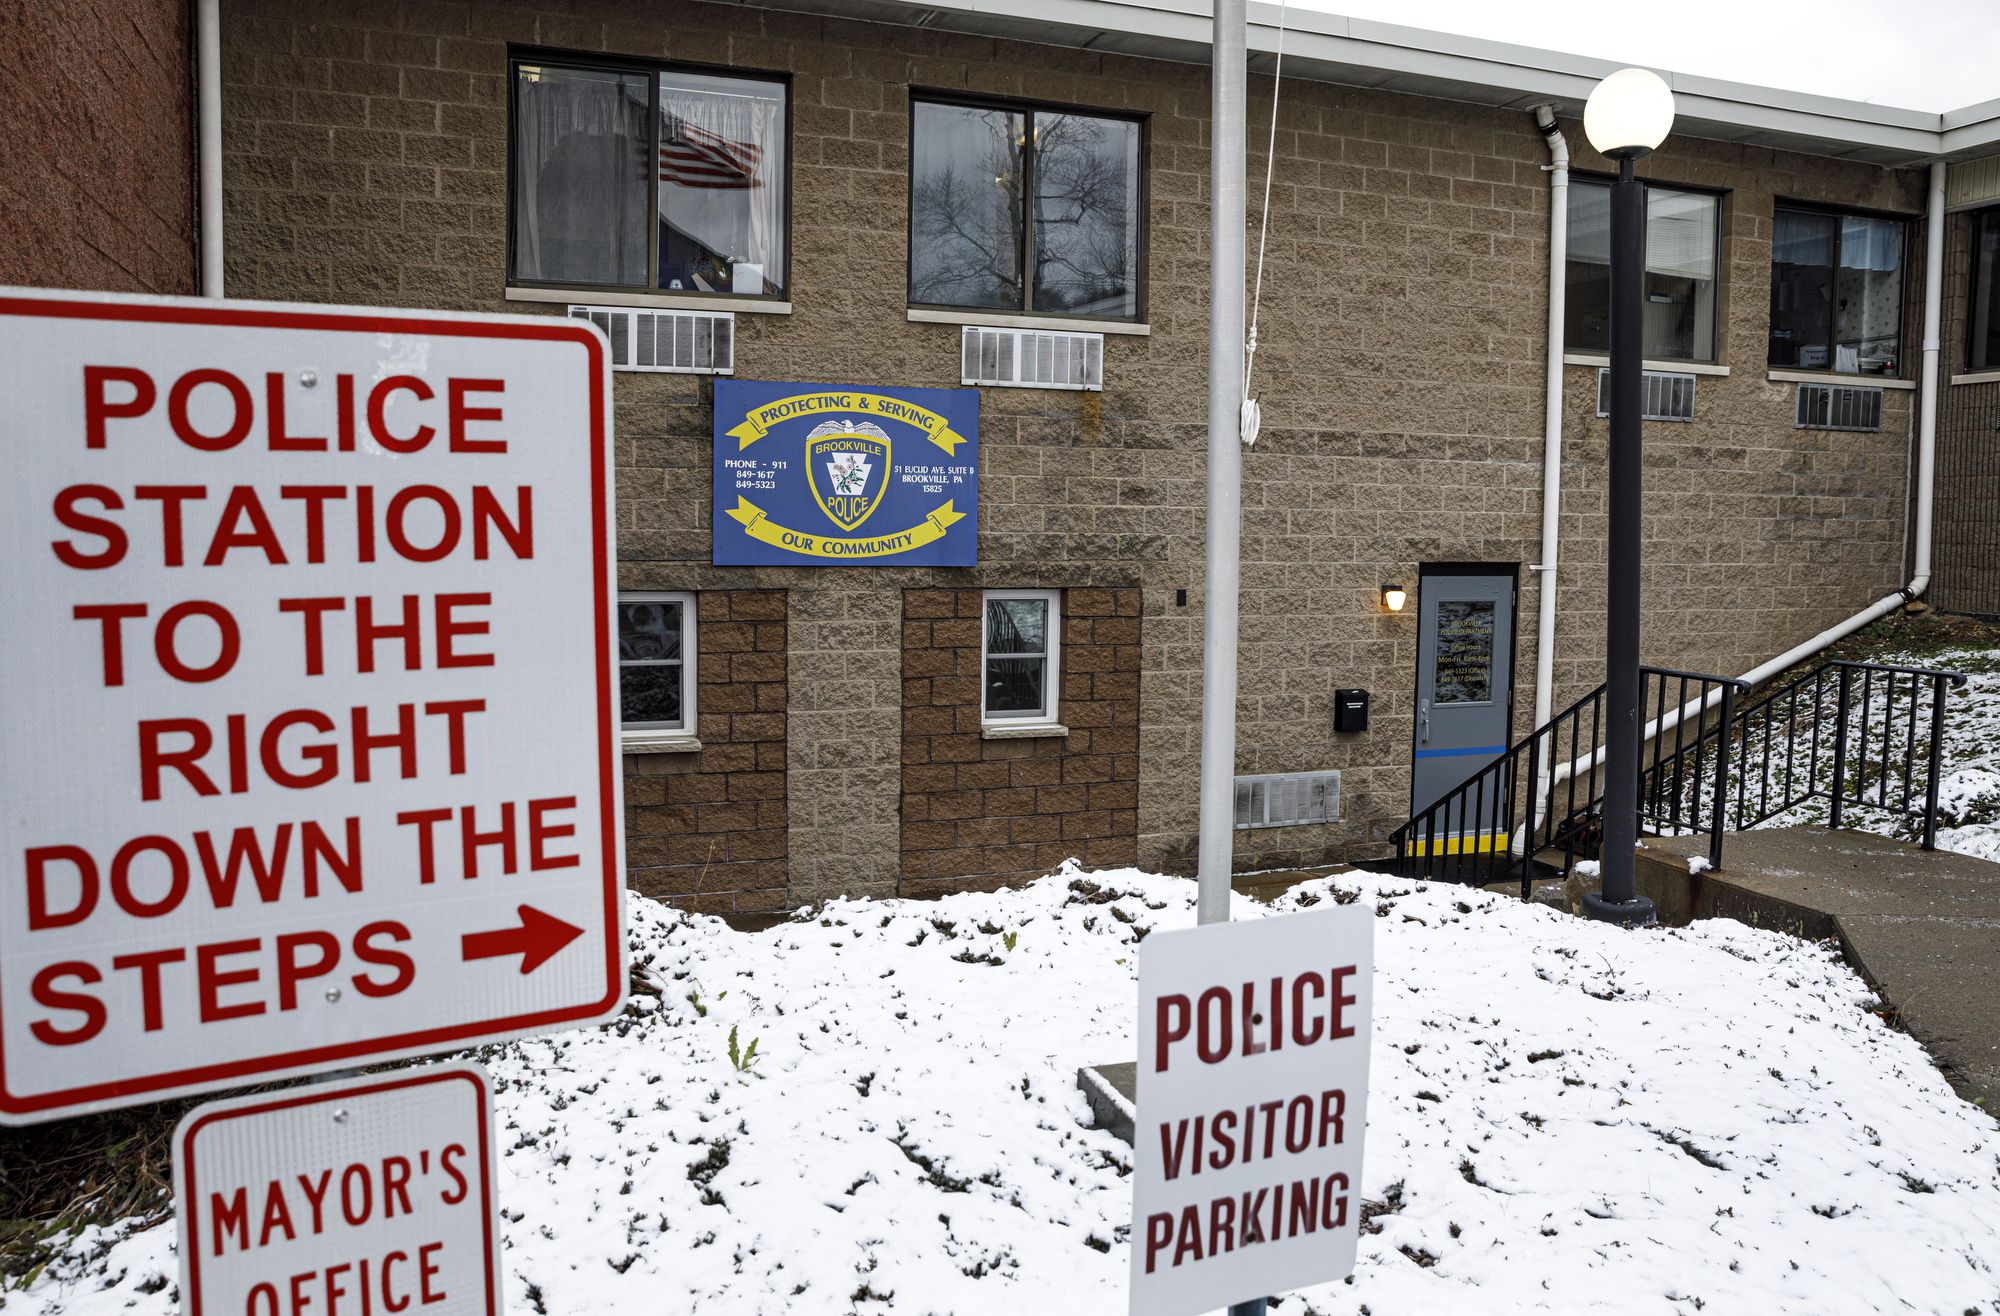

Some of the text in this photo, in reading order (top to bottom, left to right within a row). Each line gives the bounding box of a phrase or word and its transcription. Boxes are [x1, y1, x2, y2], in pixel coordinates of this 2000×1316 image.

[83, 365, 508, 454] POLICE
[759, 395, 935, 429] PROTECTING & SERVING
[724, 459, 757, 469] PHONE
[771, 461, 787, 469] 911
[735, 480, 776, 489] 849-5323
[736, 470, 776, 479] 849-1617
[815, 440, 882, 457] BROOKVILLE
[894, 465, 975, 475] 51 EUCLID AVE. SUITE B
[902, 474, 963, 484] BROOKVILLE, PA
[828, 496, 869, 522] POLICE
[922, 484, 943, 493] 15825
[51, 484, 533, 570] STATION
[781, 532, 913, 554] OUR COMMUNITY
[73, 592, 495, 687] TO THE
[138, 699, 486, 801] RIGHT
[25, 796, 580, 931] DOWN THE
[29, 920, 416, 1047] STEPS
[1155, 965, 1357, 1073] POLICE
[1159, 1088, 1346, 1181] VISITOR
[211, 1143, 468, 1257] MAYOR'S
[1145, 1172, 1349, 1275] PARKING
[246, 1242, 447, 1316] OFFICE
